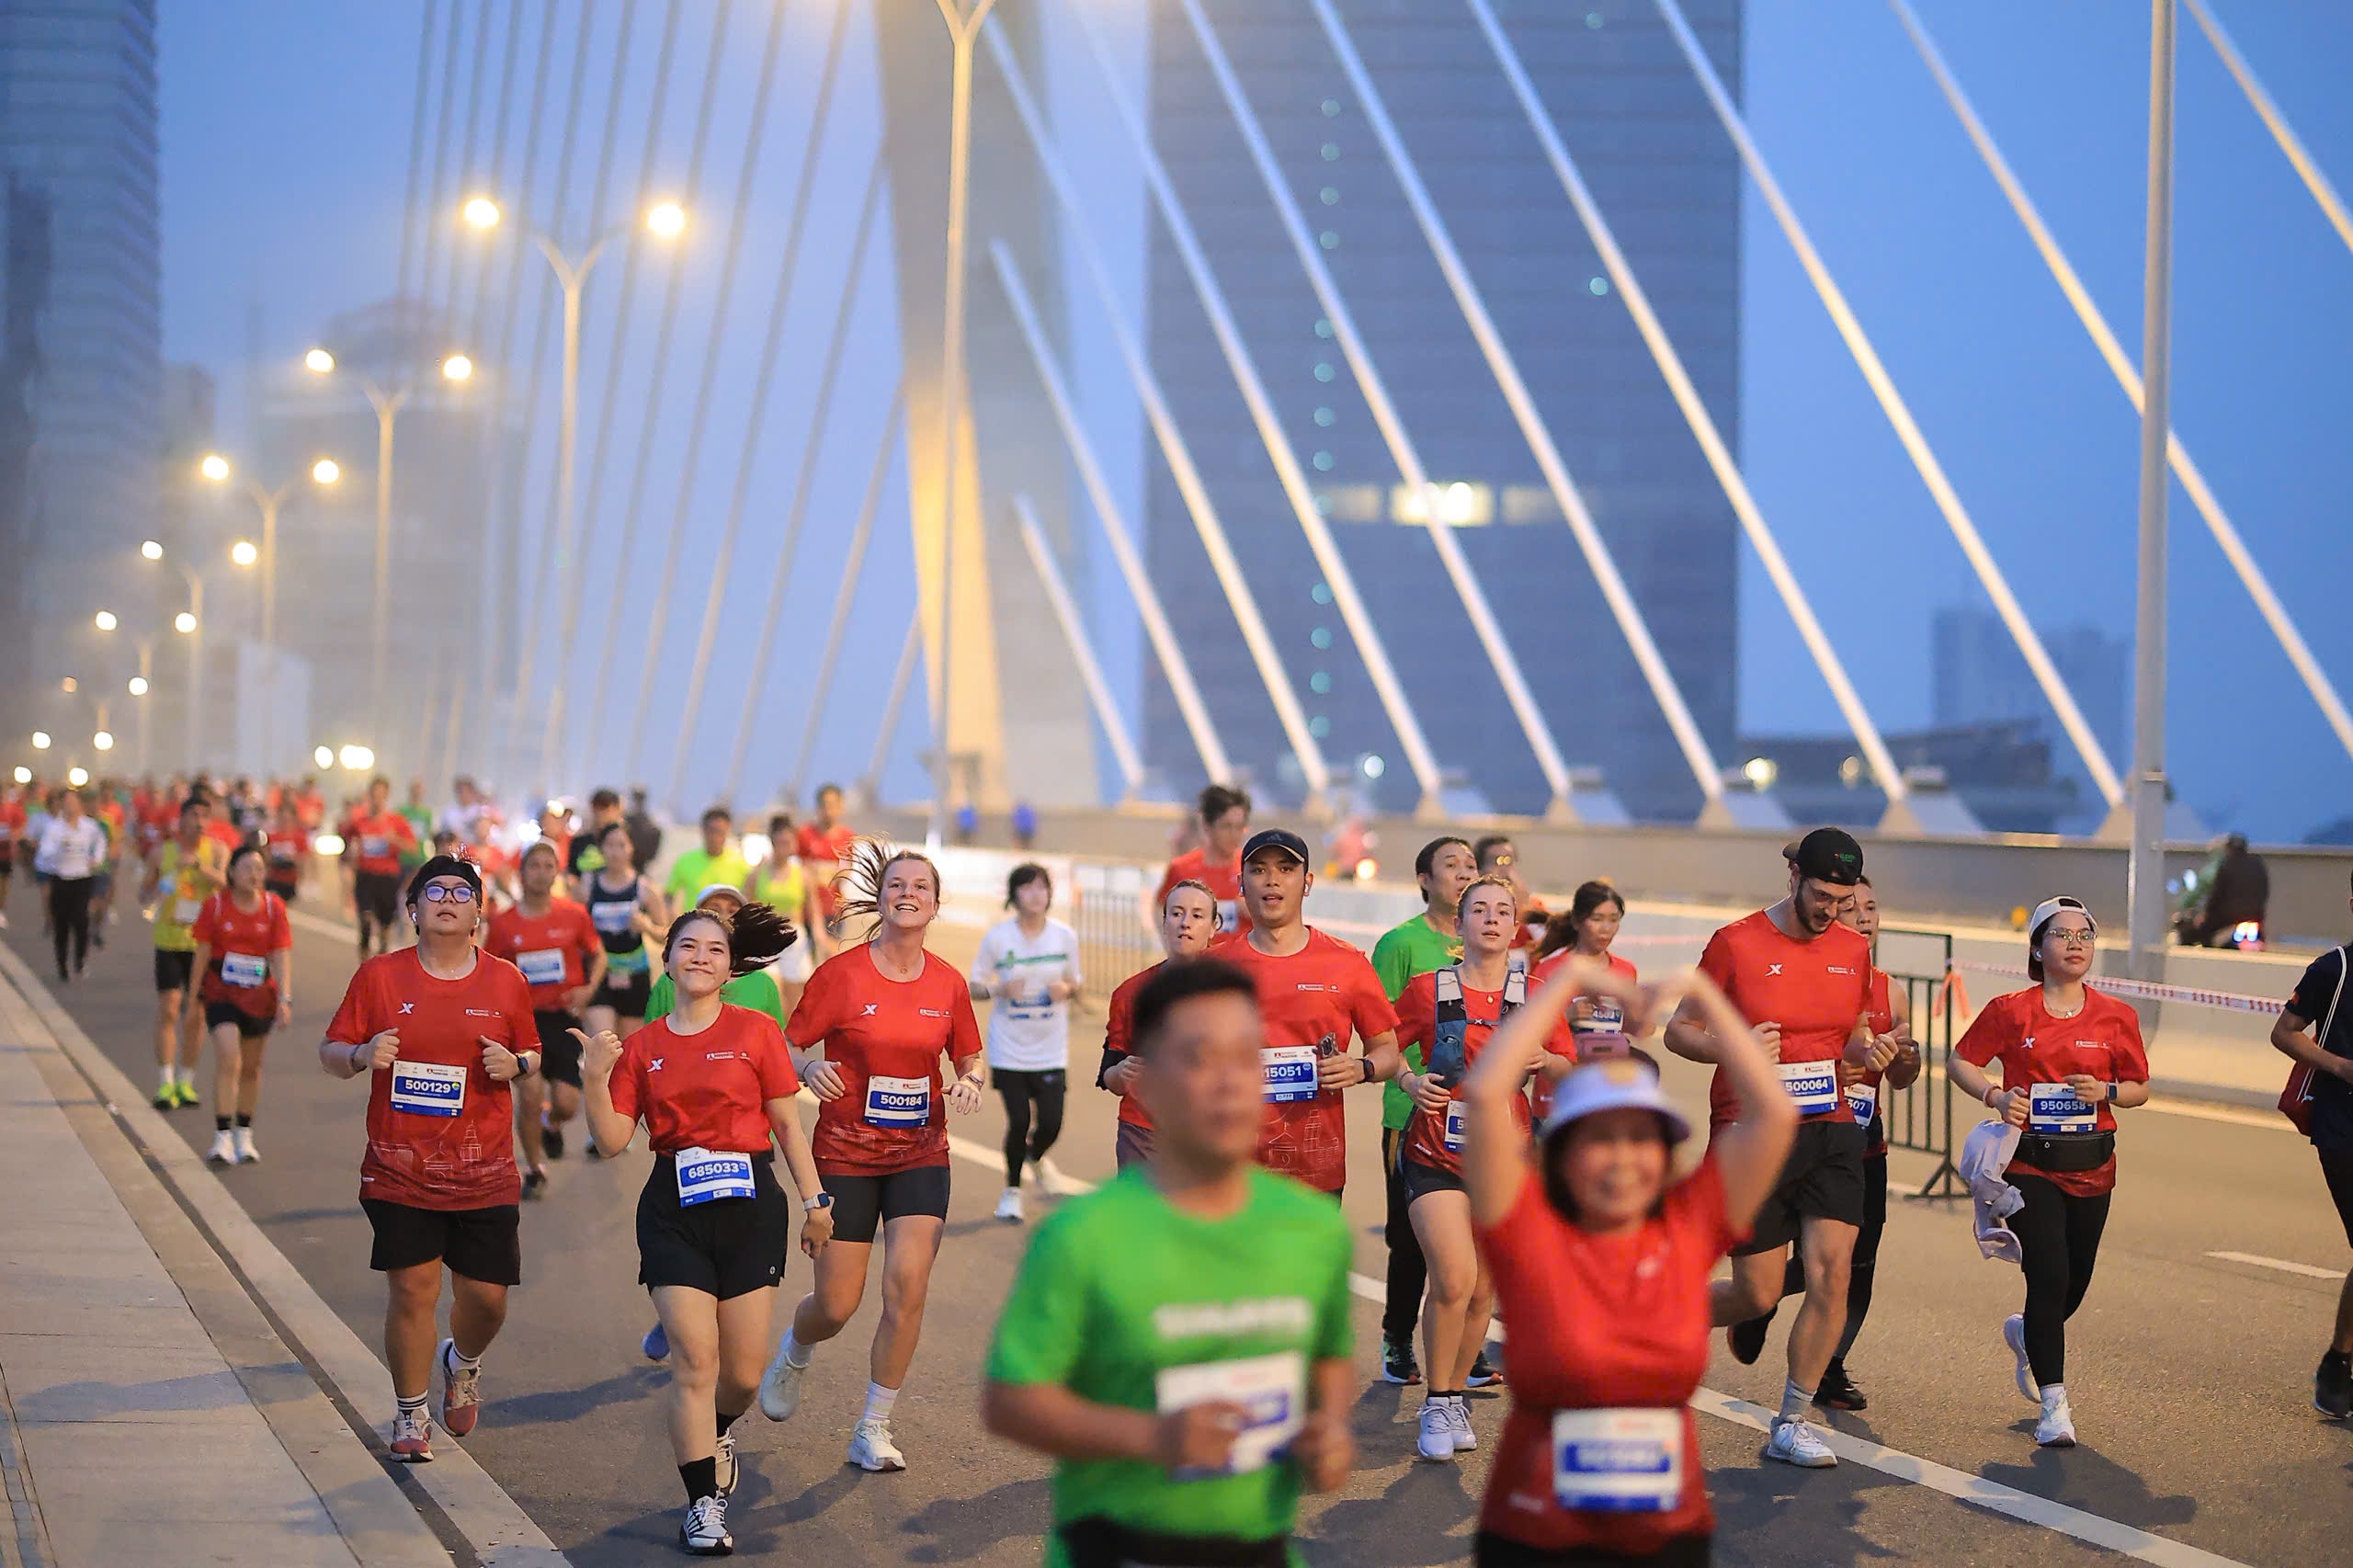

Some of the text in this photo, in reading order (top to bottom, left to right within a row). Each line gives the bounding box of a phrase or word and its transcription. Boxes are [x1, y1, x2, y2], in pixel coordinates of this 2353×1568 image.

[404, 1078, 451, 1094] 500129
[1785, 1077, 1829, 1092] 500064
[880, 1094, 923, 1107] 500184
[1845, 1097, 1867, 1111] 507
[688, 1161, 740, 1179] 685033
